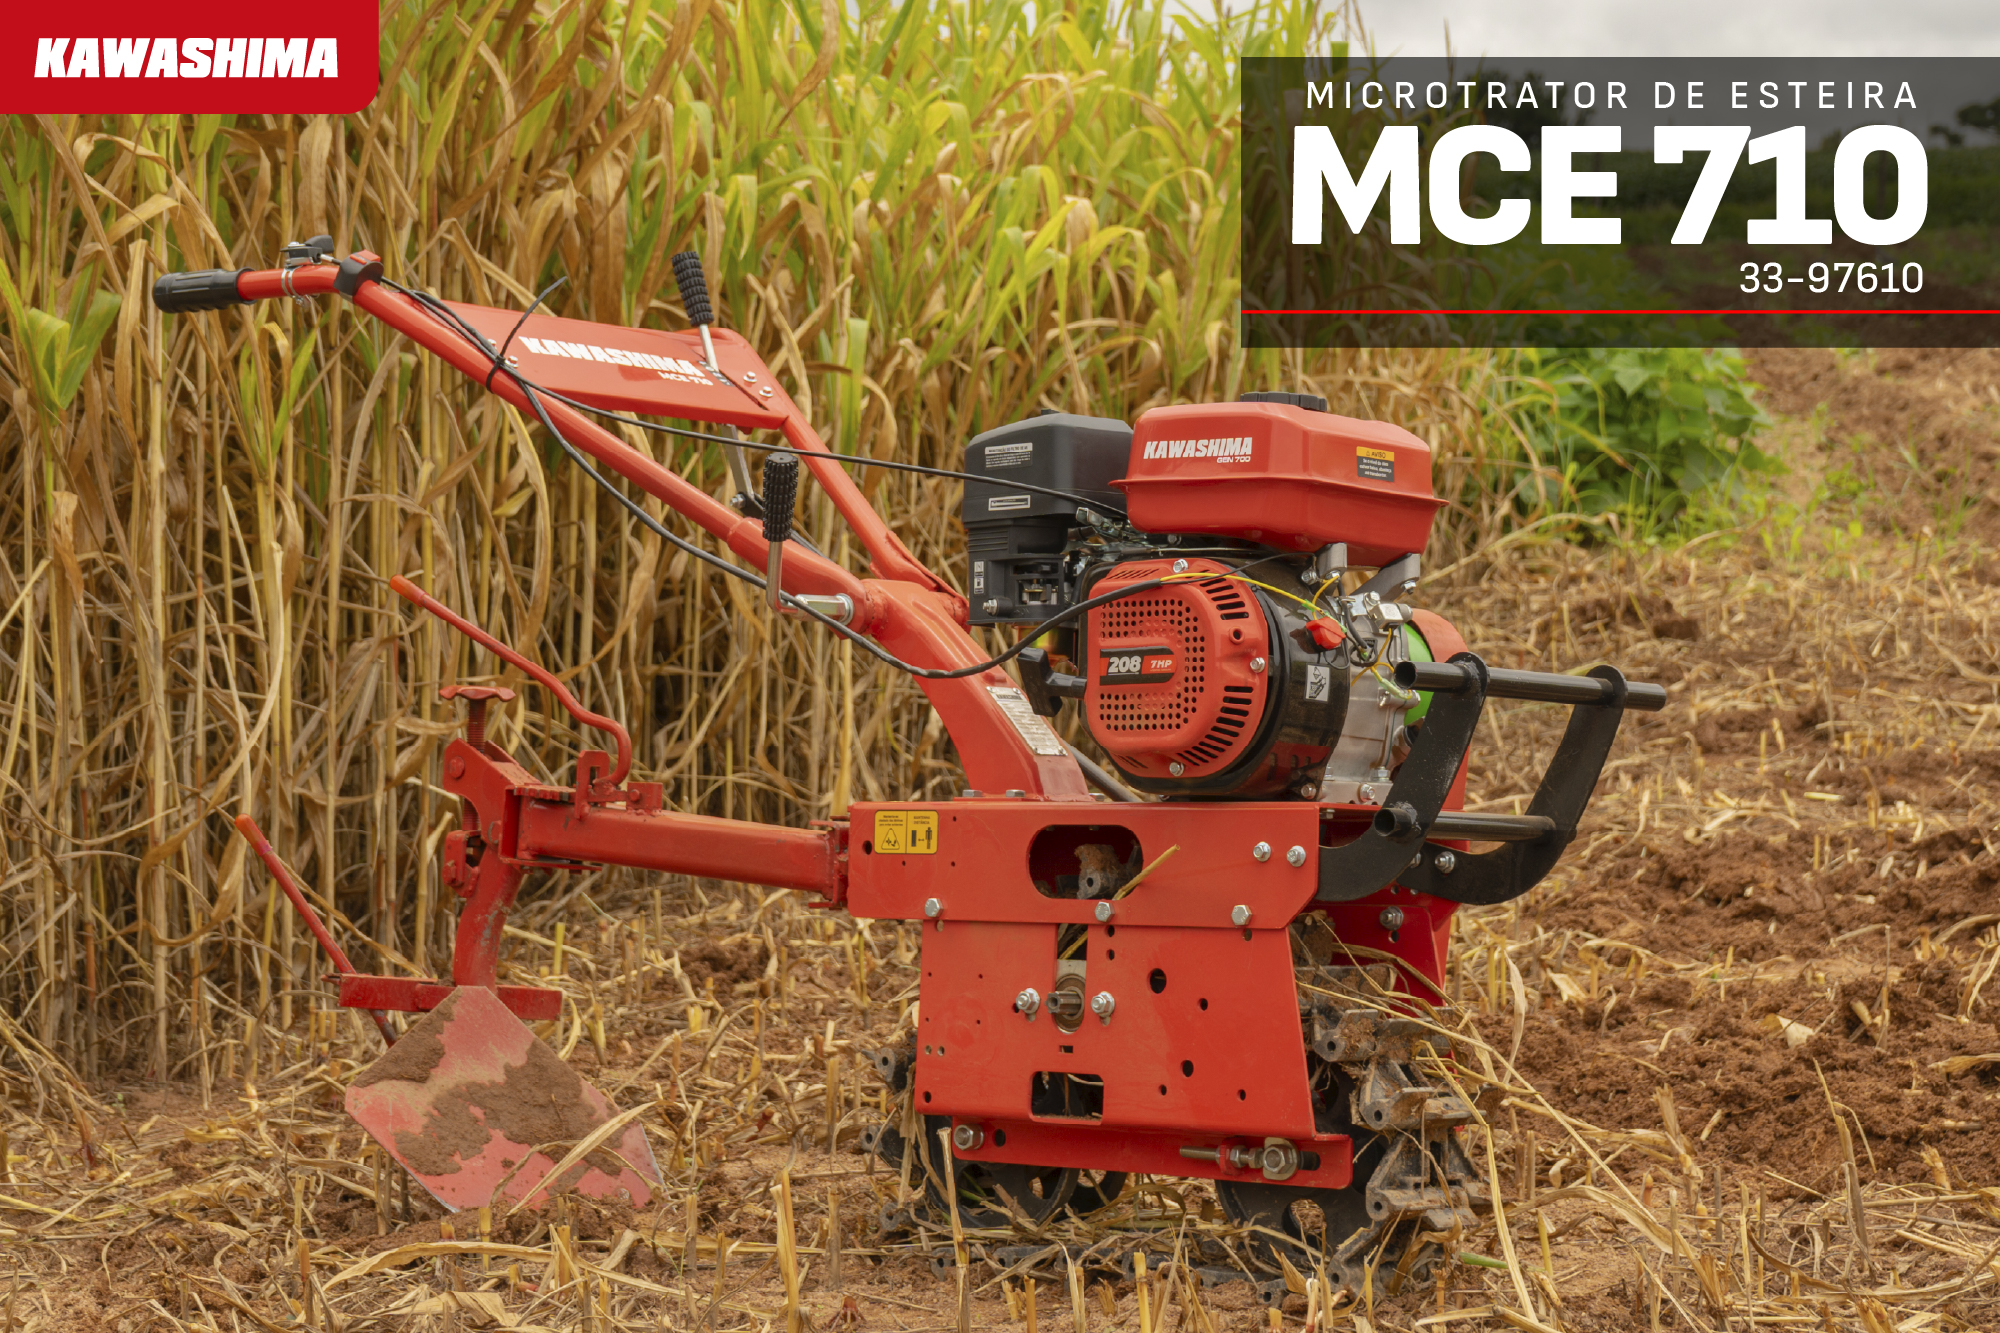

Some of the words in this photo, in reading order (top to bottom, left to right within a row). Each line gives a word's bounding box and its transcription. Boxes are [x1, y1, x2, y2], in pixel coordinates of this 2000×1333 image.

[518, 336, 706, 377] KAWASHIMA
[657, 371, 691, 383] MCE
[1143, 437, 1253, 459] KAWASHIMA
[1108, 656, 1141, 673] 208
[1150, 660, 1172, 668] 7HP
